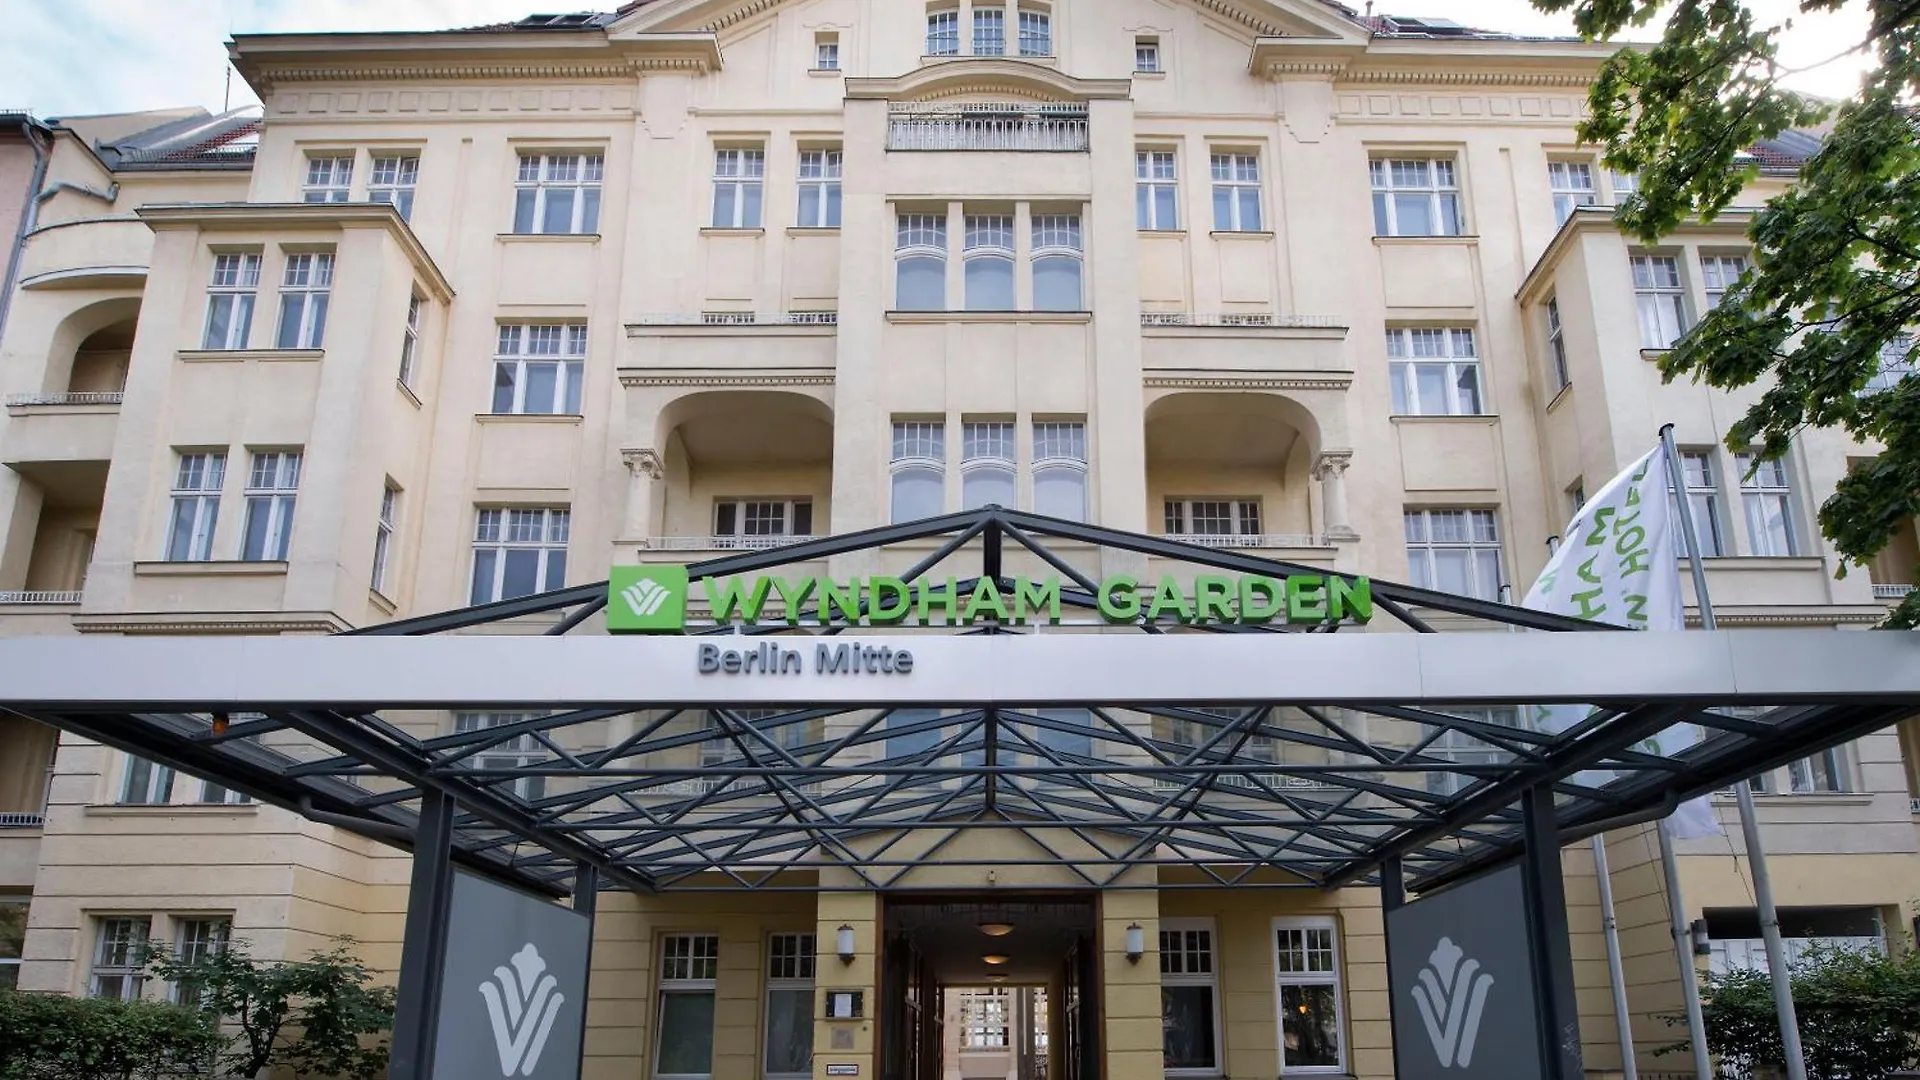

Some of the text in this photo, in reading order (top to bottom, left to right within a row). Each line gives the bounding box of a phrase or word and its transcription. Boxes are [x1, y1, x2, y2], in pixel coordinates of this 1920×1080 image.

[701, 574, 1373, 625] WYNDHAM GARDEN
[698, 641, 914, 674] Berlin Mitte
